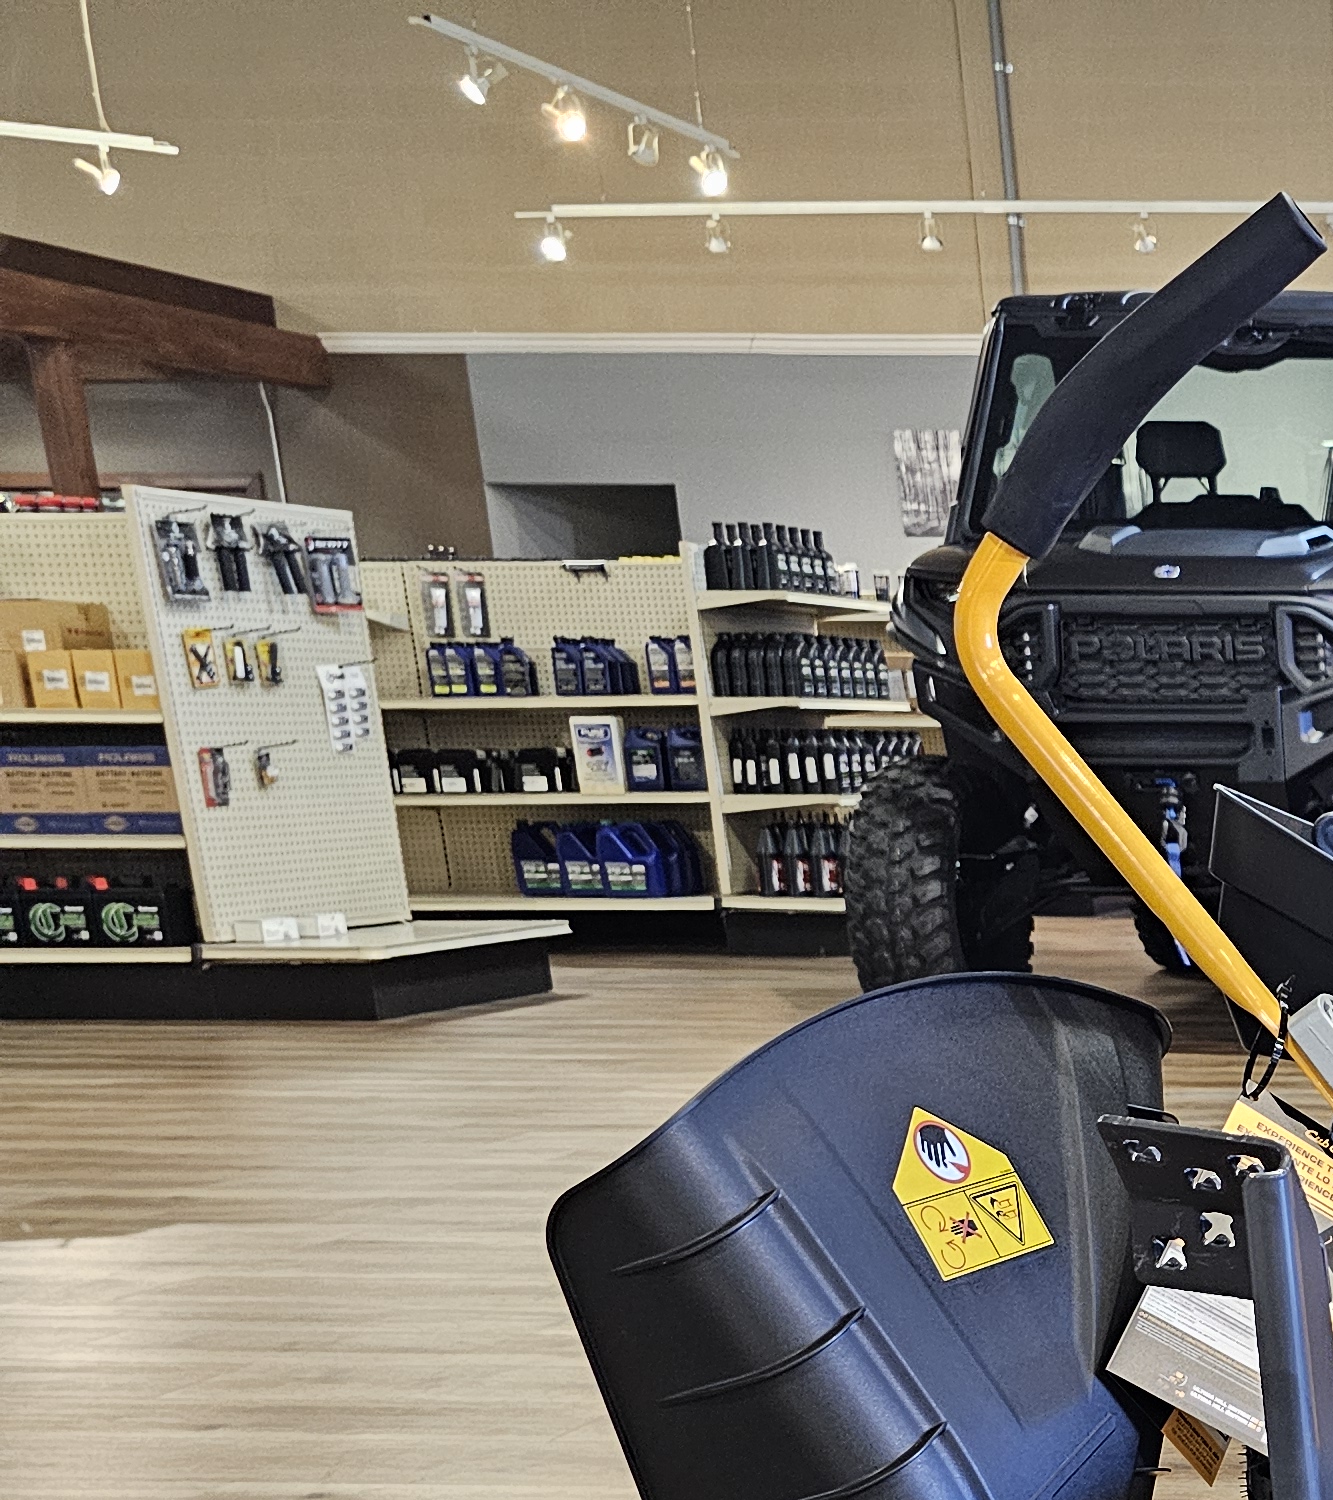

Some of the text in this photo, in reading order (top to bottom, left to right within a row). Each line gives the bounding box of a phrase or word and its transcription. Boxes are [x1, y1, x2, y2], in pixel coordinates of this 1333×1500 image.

[1070, 634, 1266, 662] POLARIS
[1256, 1122, 1325, 1168] EXPERIENCE
[1305, 1129, 1330, 1149] Cub
[1316, 1171, 1331, 1185] LO
